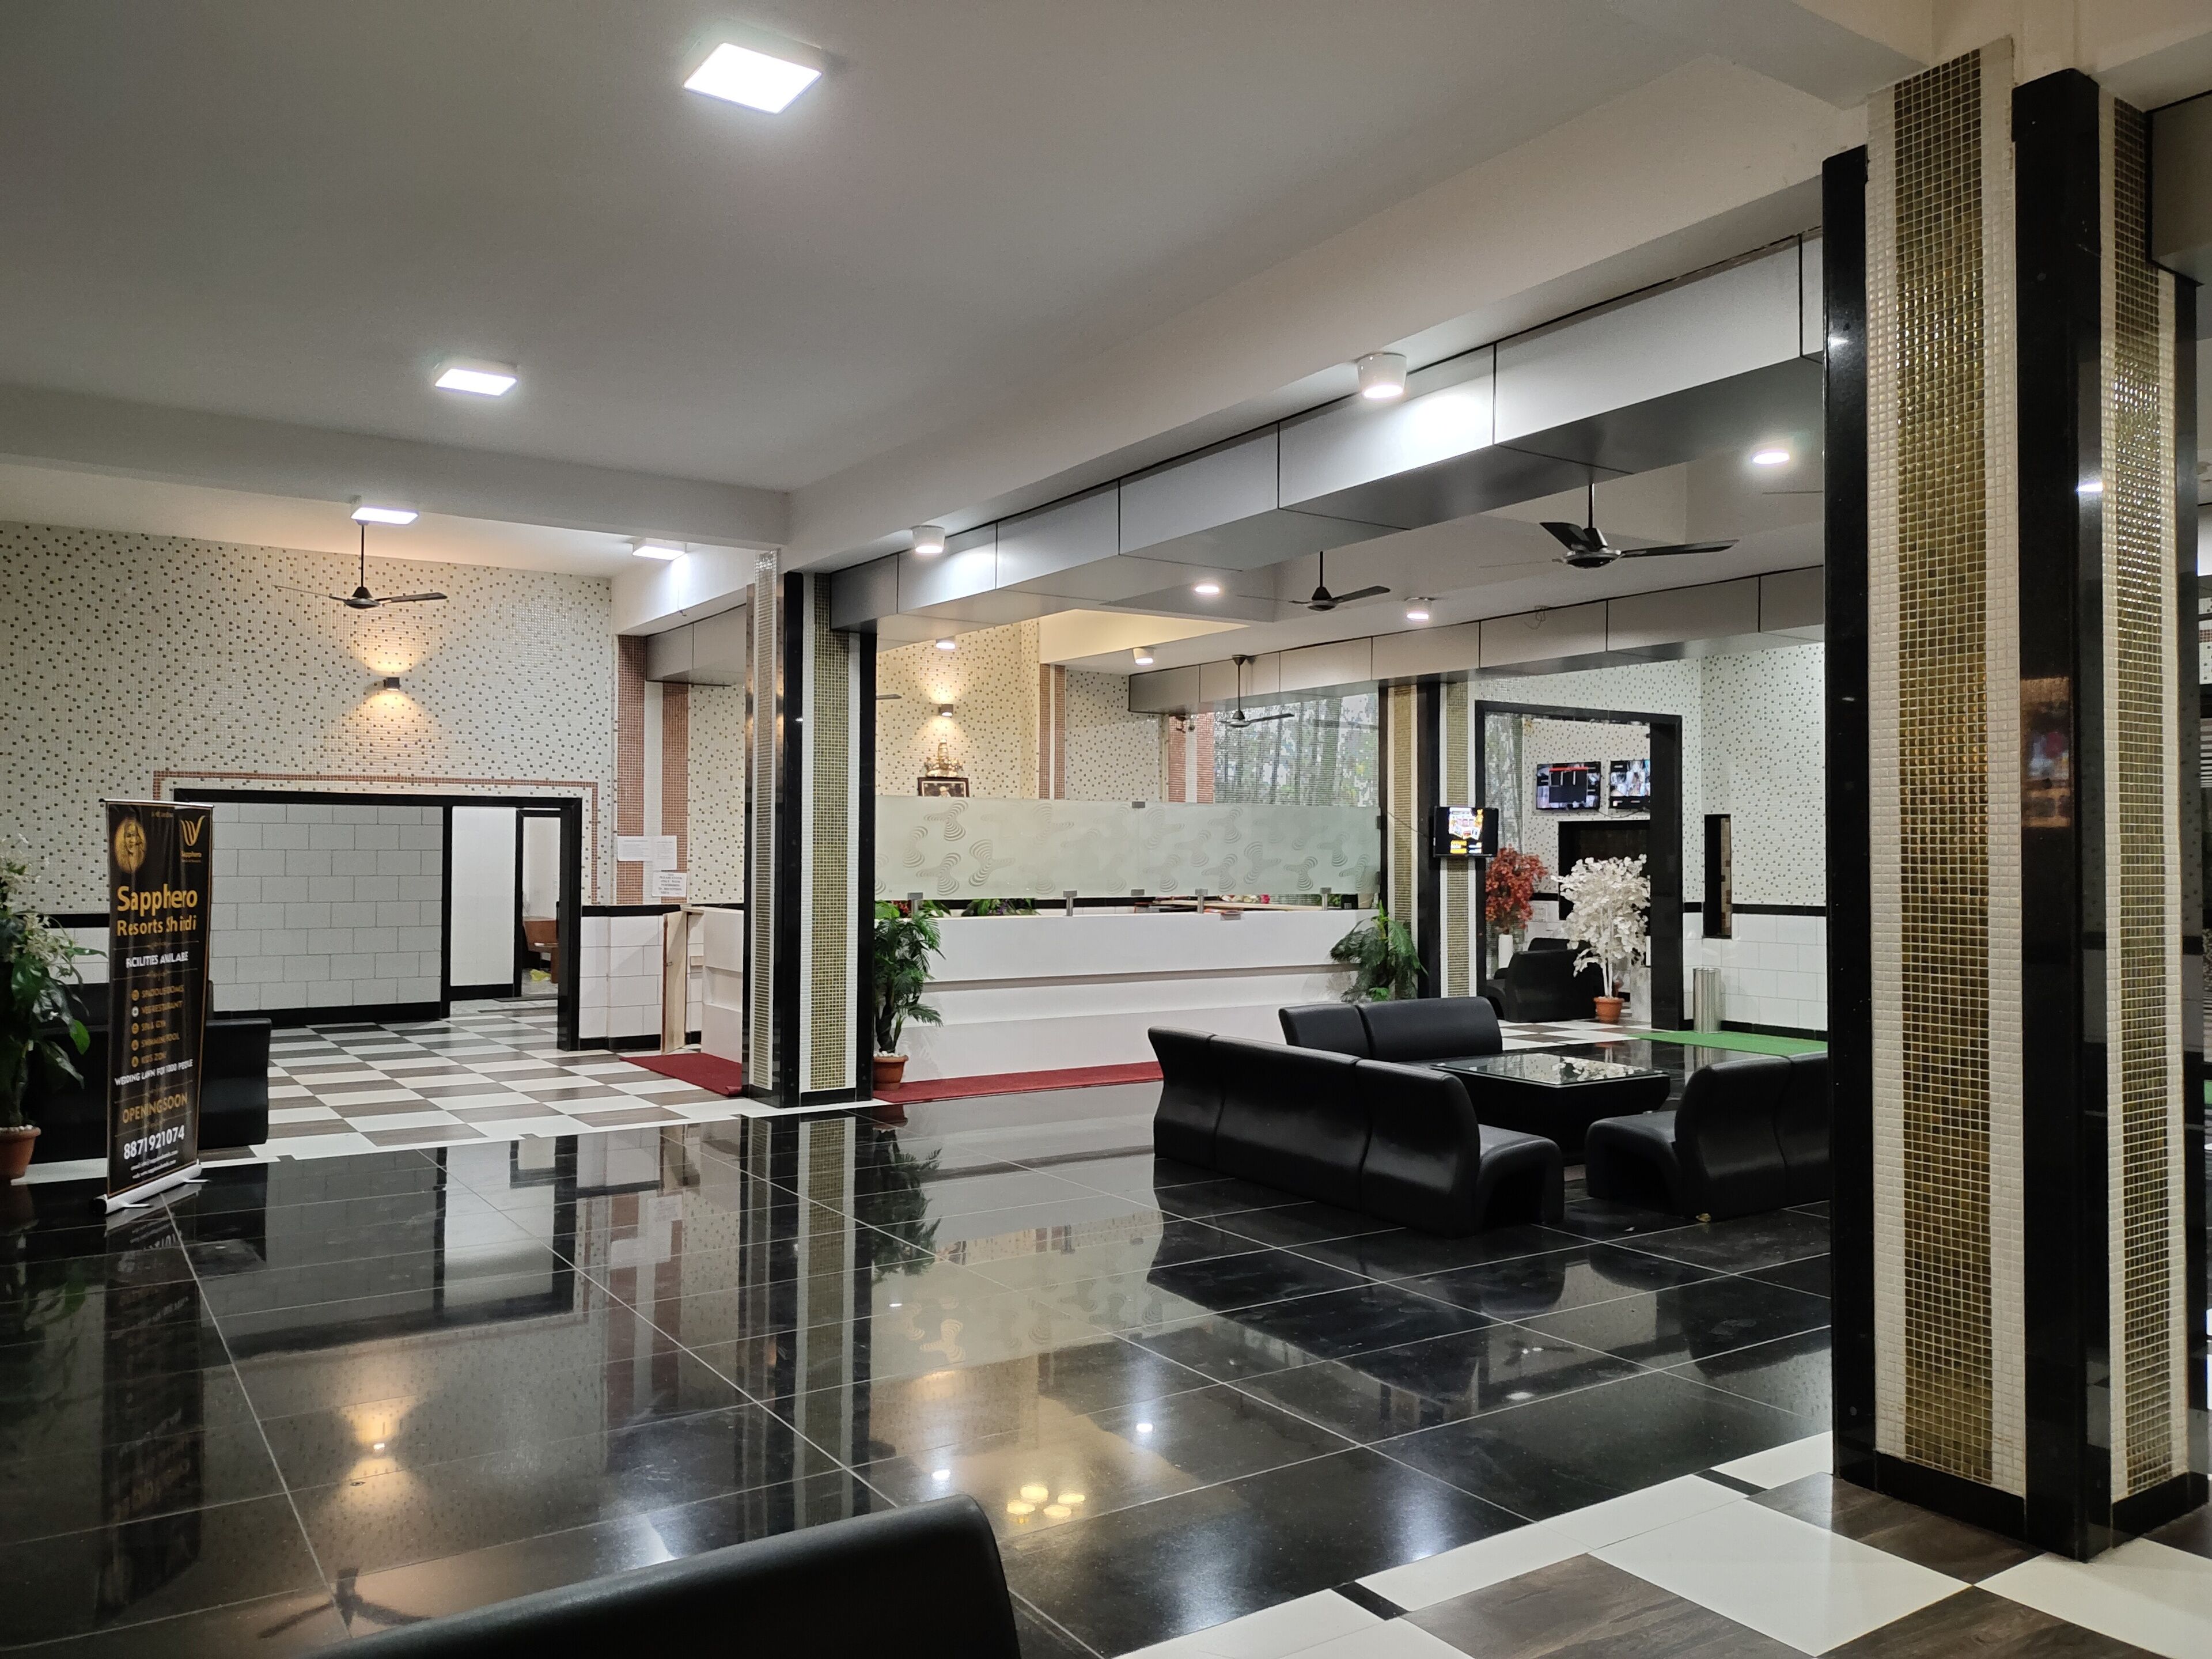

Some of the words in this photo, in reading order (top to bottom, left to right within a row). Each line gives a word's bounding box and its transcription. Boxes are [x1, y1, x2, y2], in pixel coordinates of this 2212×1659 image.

[117, 884, 198, 916] Sapphero
[117, 919, 163, 936] Resorts
[124, 1125, 184, 1160] 8871921074
